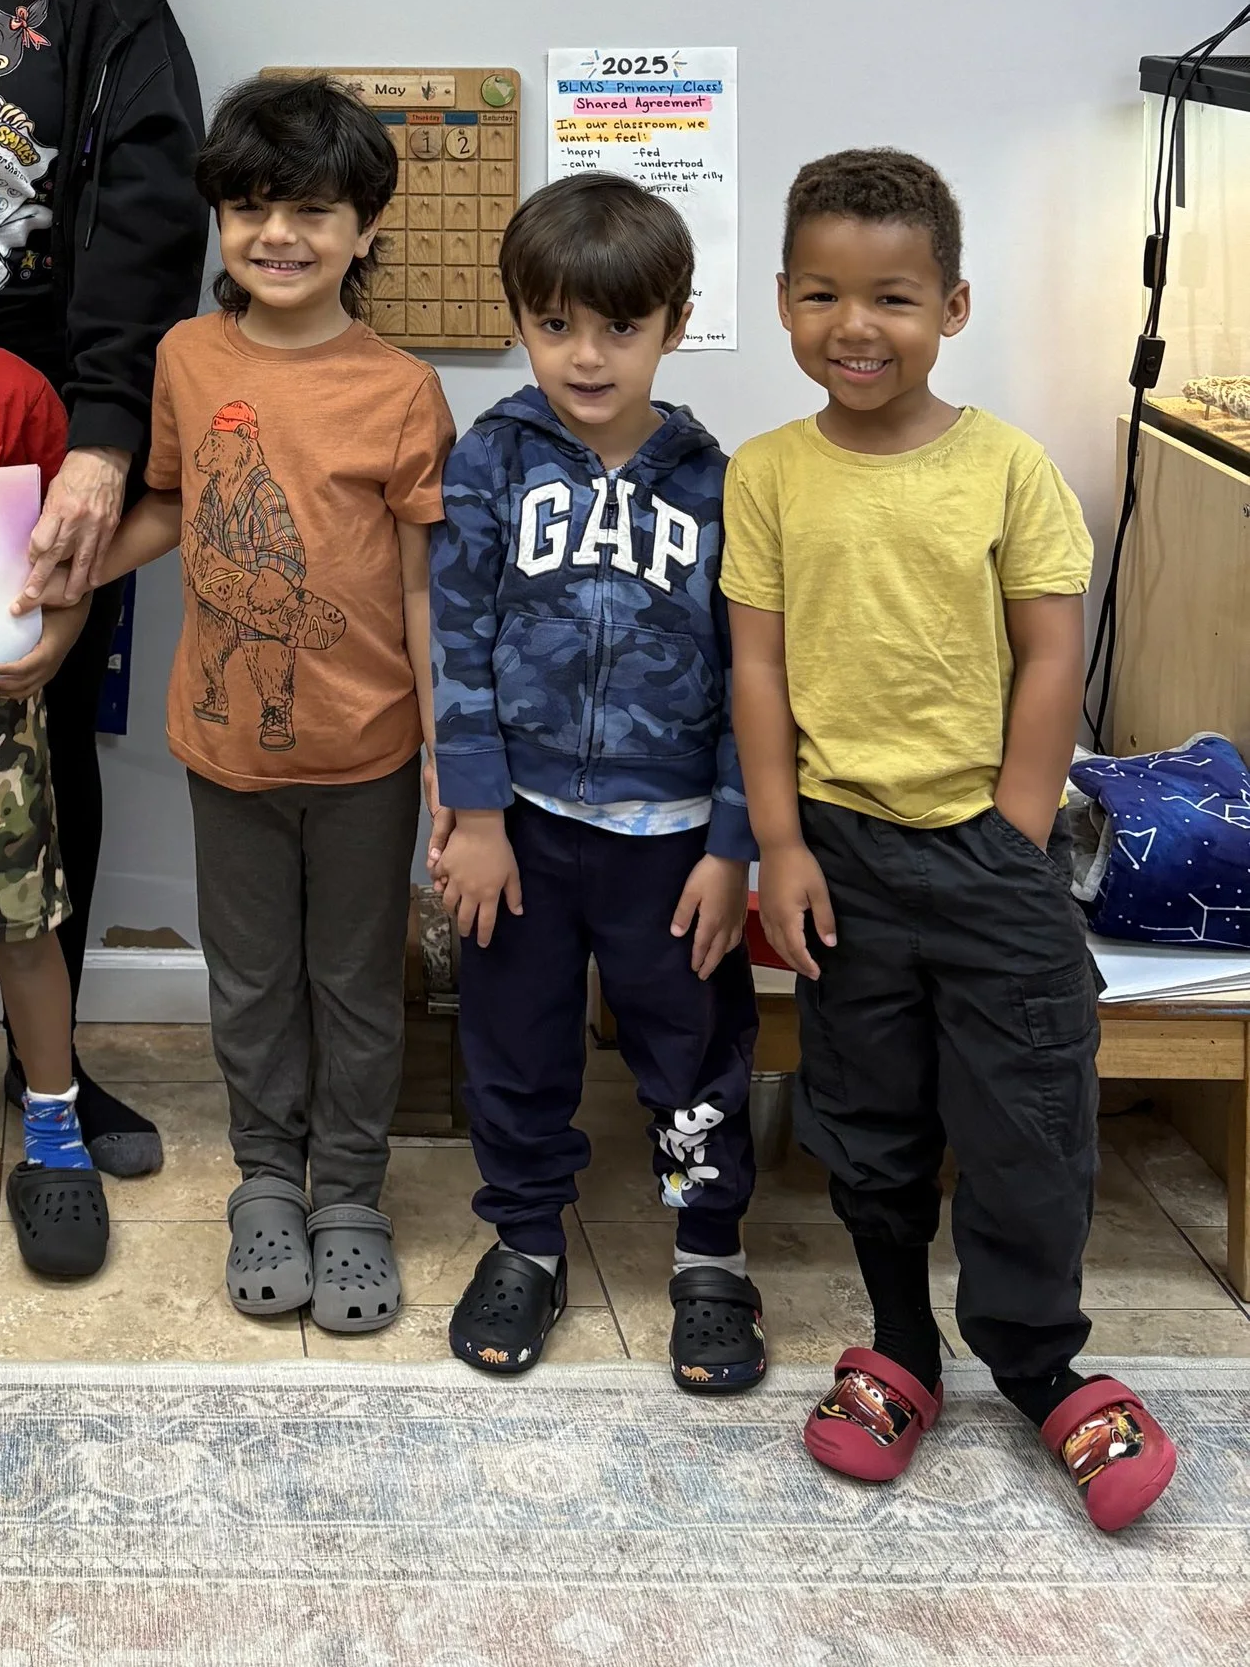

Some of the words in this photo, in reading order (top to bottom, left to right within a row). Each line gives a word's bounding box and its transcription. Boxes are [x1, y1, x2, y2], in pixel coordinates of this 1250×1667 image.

[602, 55, 669, 75] 2025
[375, 83, 406, 97] May
[617, 82, 674, 97] Primary
[576, 97, 628, 109] Shared
[635, 95, 706, 113] Agreement
[412, 114, 440, 122] Thursday
[482, 114, 513, 122] Saturday
[557, 119, 577, 130] In
[586, 121, 608, 130] our
[613, 119, 683, 131] classroom,
[687, 121, 705, 129] we
[421, 136, 430, 154] 1
[559, 134, 591, 143] want
[597, 133, 609, 143] to
[457, 136, 470, 155] 2
[650, 172, 678, 181] little
[682, 172, 698, 180] bit
[516, 477, 699, 592] GAP
